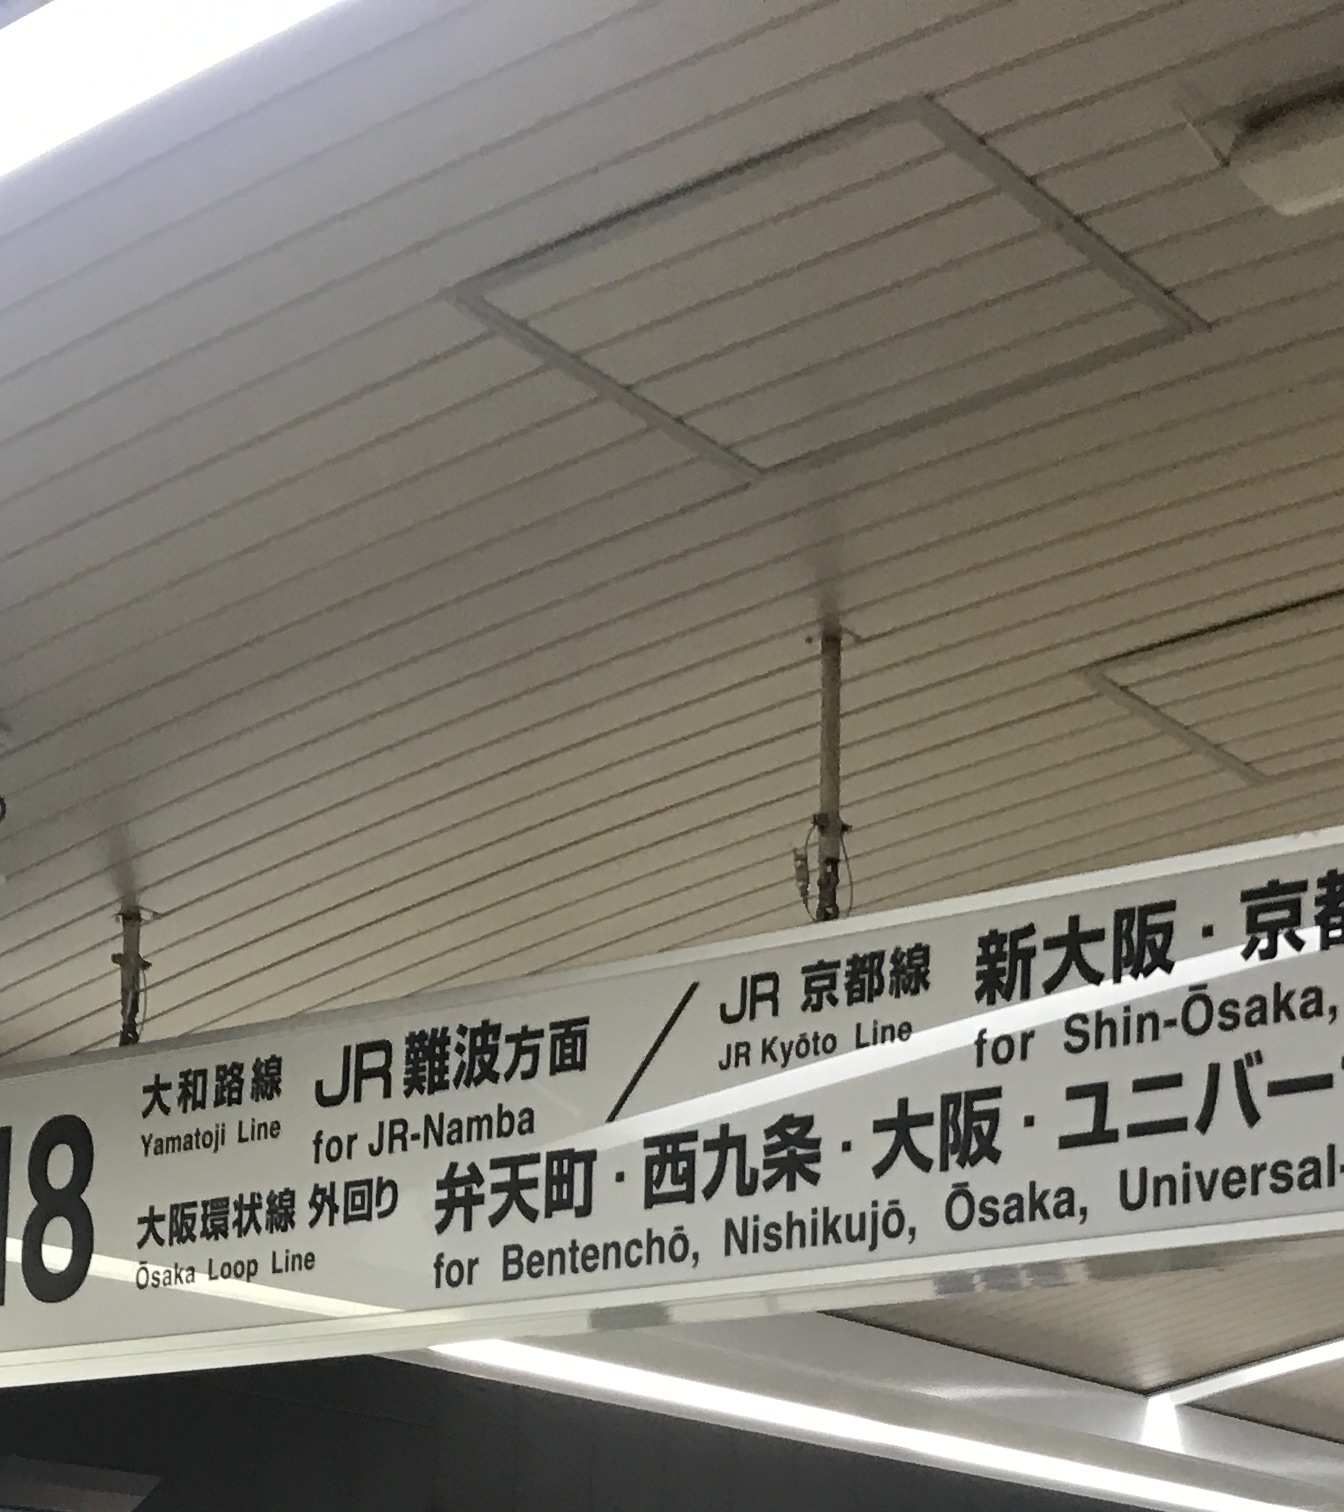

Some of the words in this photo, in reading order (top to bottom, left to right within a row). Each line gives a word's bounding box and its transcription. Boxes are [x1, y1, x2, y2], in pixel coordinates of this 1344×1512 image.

[718, 1043, 753, 1071] JR
[761, 1031, 838, 1069] Kyōto
[855, 1016, 913, 1052] Line
[974, 1027, 1035, 1070] for
[1064, 984, 1339, 1056] Shin-Ōsaka,
[141, 1054, 284, 1119] 大和路線
[140, 1120, 226, 1159] Yamatoji
[237, 1116, 281, 1145] Line
[313, 1127, 358, 1163] for
[368, 1105, 536, 1158] JR-Namba
[136, 1187, 297, 1249] 大阪環状線
[307, 1176, 399, 1229] 外回り
[433, 1252, 478, 1289] for
[501, 1224, 700, 1282] Bentenchō,
[723, 1202, 917, 1259] Nishikujō,
[944, 1180, 1088, 1232] Ōsaka,
[135, 1259, 196, 1290] Ōsaka
[208, 1254, 258, 1285] Loop
[271, 1248, 316, 1275] Line
